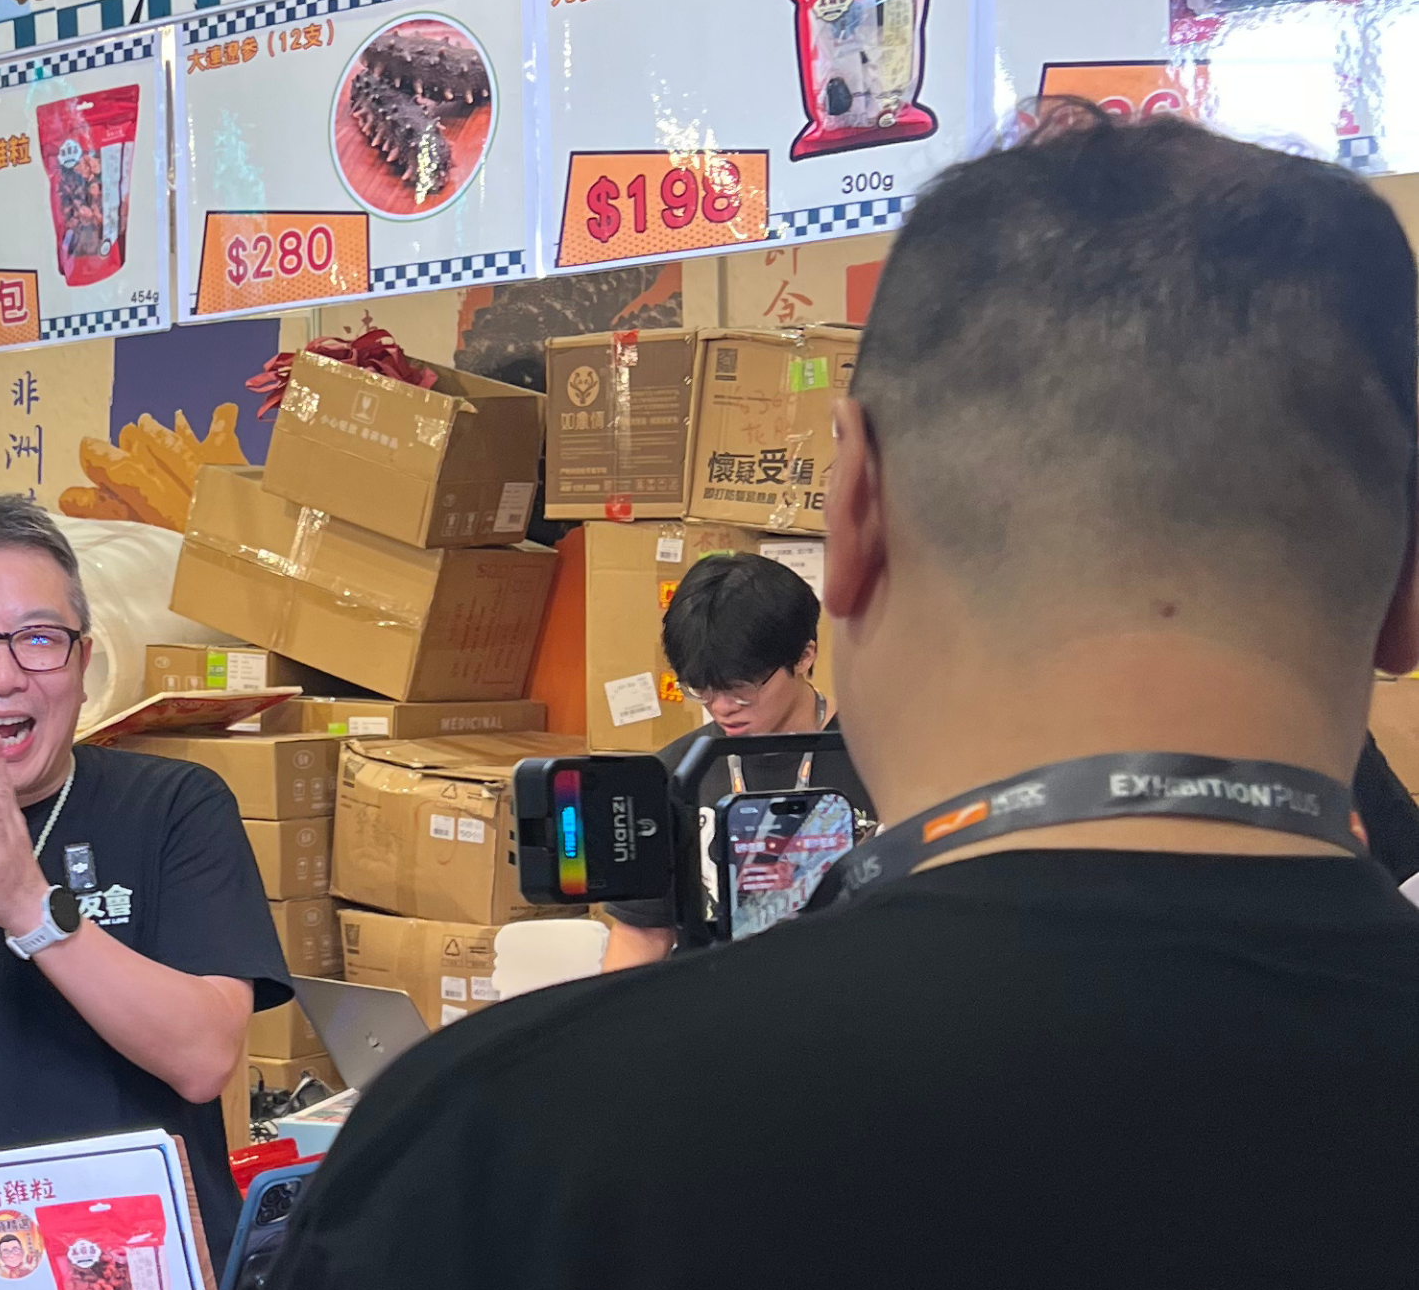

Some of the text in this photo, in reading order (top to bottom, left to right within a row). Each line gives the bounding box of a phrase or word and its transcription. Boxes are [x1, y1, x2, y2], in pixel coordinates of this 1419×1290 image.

[585, 159, 745, 244] $198
[839, 171, 895, 195] 300g
[225, 224, 334, 287] $280
[130, 290, 159, 305] 454g
[6, 371, 42, 504] 非洲
[440, 716, 504, 731] MEDICINAL
[611, 796, 629, 862] Ulanzi
